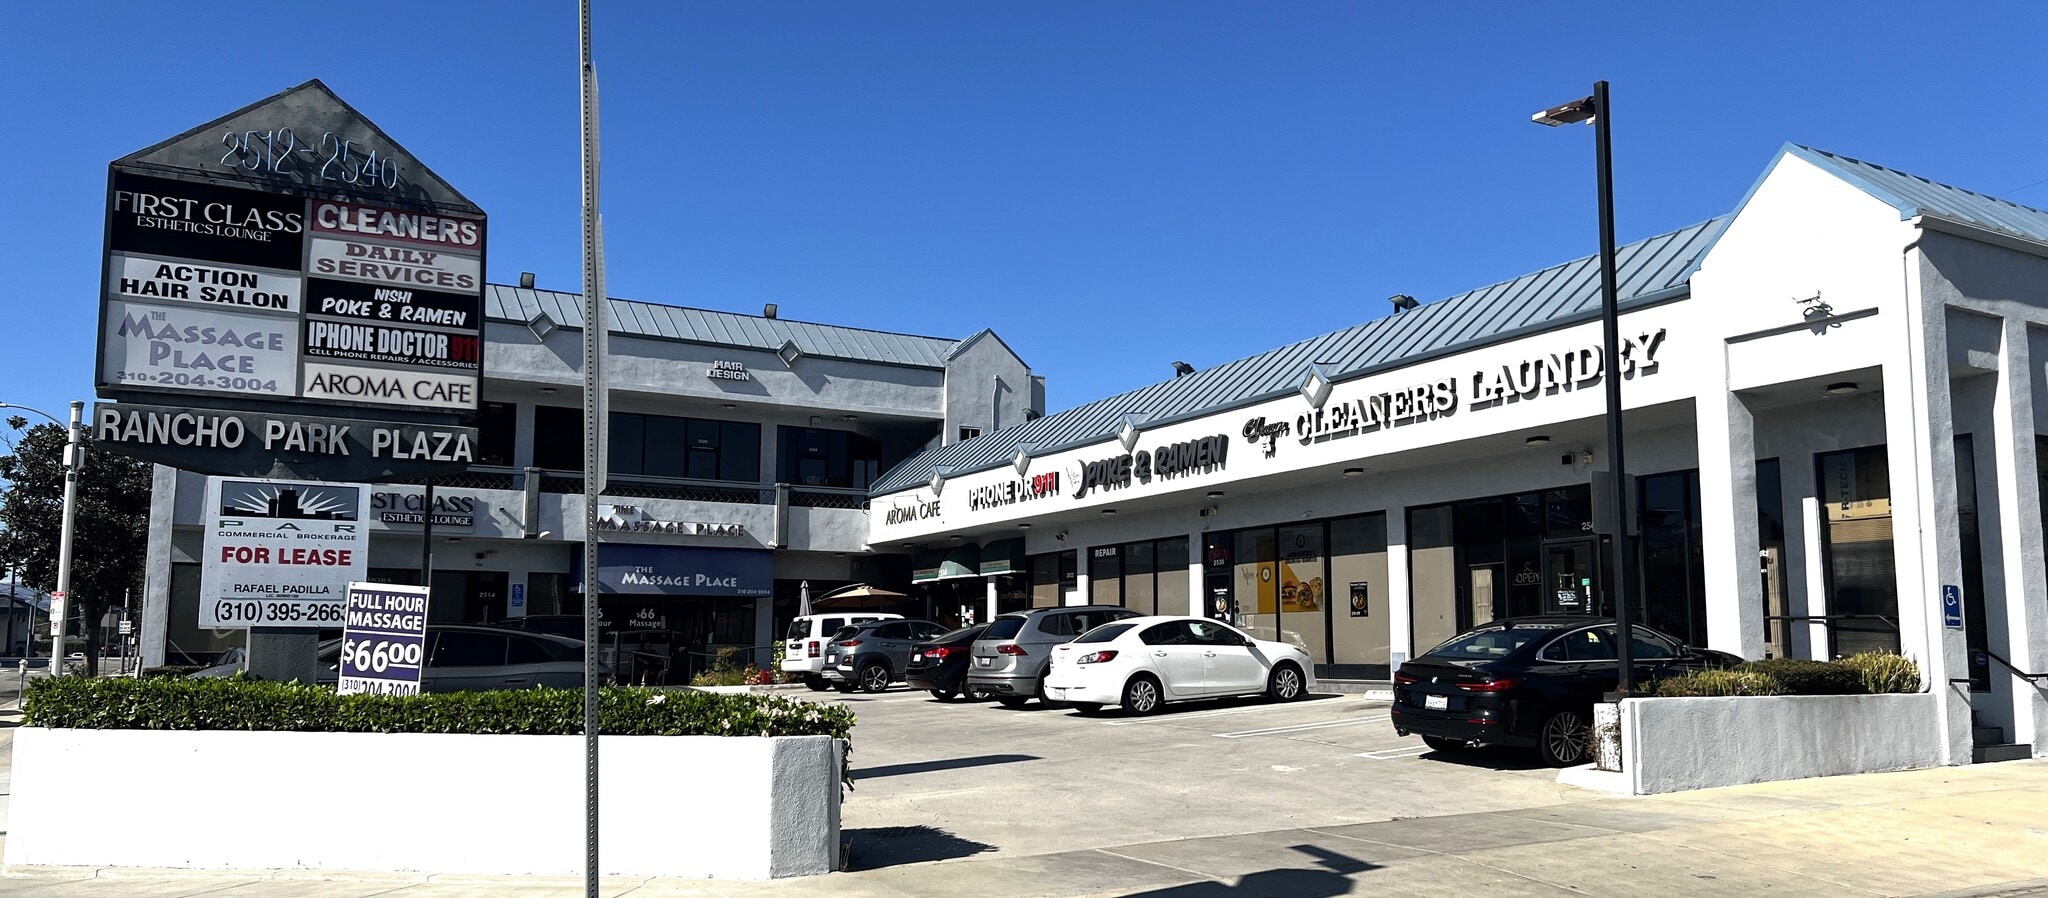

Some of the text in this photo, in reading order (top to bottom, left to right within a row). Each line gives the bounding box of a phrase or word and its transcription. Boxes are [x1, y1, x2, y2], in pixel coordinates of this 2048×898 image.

[220, 127, 398, 189] 2512-2540
[114, 190, 302, 233] FIRST CLASS
[137, 215, 272, 243] ESTHETICS LOUNGE
[317, 203, 478, 246] CLEANERS
[346, 243, 438, 266] DAILY
[155, 264, 259, 289] ACTION
[316, 258, 475, 288] SERVICES
[120, 278, 288, 309] HAIR SALON
[374, 289, 412, 304] NISHI
[150, 311, 167, 322] THE
[321, 298, 467, 327] POKE & RAMEN
[118, 311, 284, 352] MASSAGE
[308, 321, 478, 362] IPHONE DOCTOR 911
[149, 340, 255, 374] PLACE
[309, 348, 332, 356] CELL
[333, 351, 368, 359] PHONE
[370, 354, 409, 363] REPAIRS
[418, 358, 478, 369] ACCESSORIES
[714, 360, 743, 371] HAIR
[706, 369, 750, 381] DESIGN
[307, 371, 473, 404] AROMA CAFE
[1294, 377, 1457, 443] CLEANERS
[99, 408, 474, 463] RANCHO PARK PLAZA
[1086, 453, 1133, 489] POKE
[1134, 450, 1152, 481] &
[1154, 434, 1229, 477] RAMEN
[434, 515, 472, 525] LOUNGE
[614, 505, 635, 515] THE
[886, 500, 941, 526] AROMA CAFE
[218, 531, 357, 541] COMMERCIAL BROKERAGE
[597, 516, 744, 537] MASSAGE PLACE
[221, 546, 352, 566] FOR LEASE
[1094, 547, 1117, 558] REPAIR
[621, 572, 737, 588] MASSAGE PLACE
[635, 566, 653, 574] THE
[1515, 571, 1540, 583] OPEN
[234, 584, 330, 594] RAFAEL PADILLA
[215, 600, 262, 623] (310)
[350, 593, 424, 613] FULL HOUR
[348, 611, 422, 631] MASSAGE
[629, 619, 661, 629] Massage
[342, 679, 360, 691] (310)
